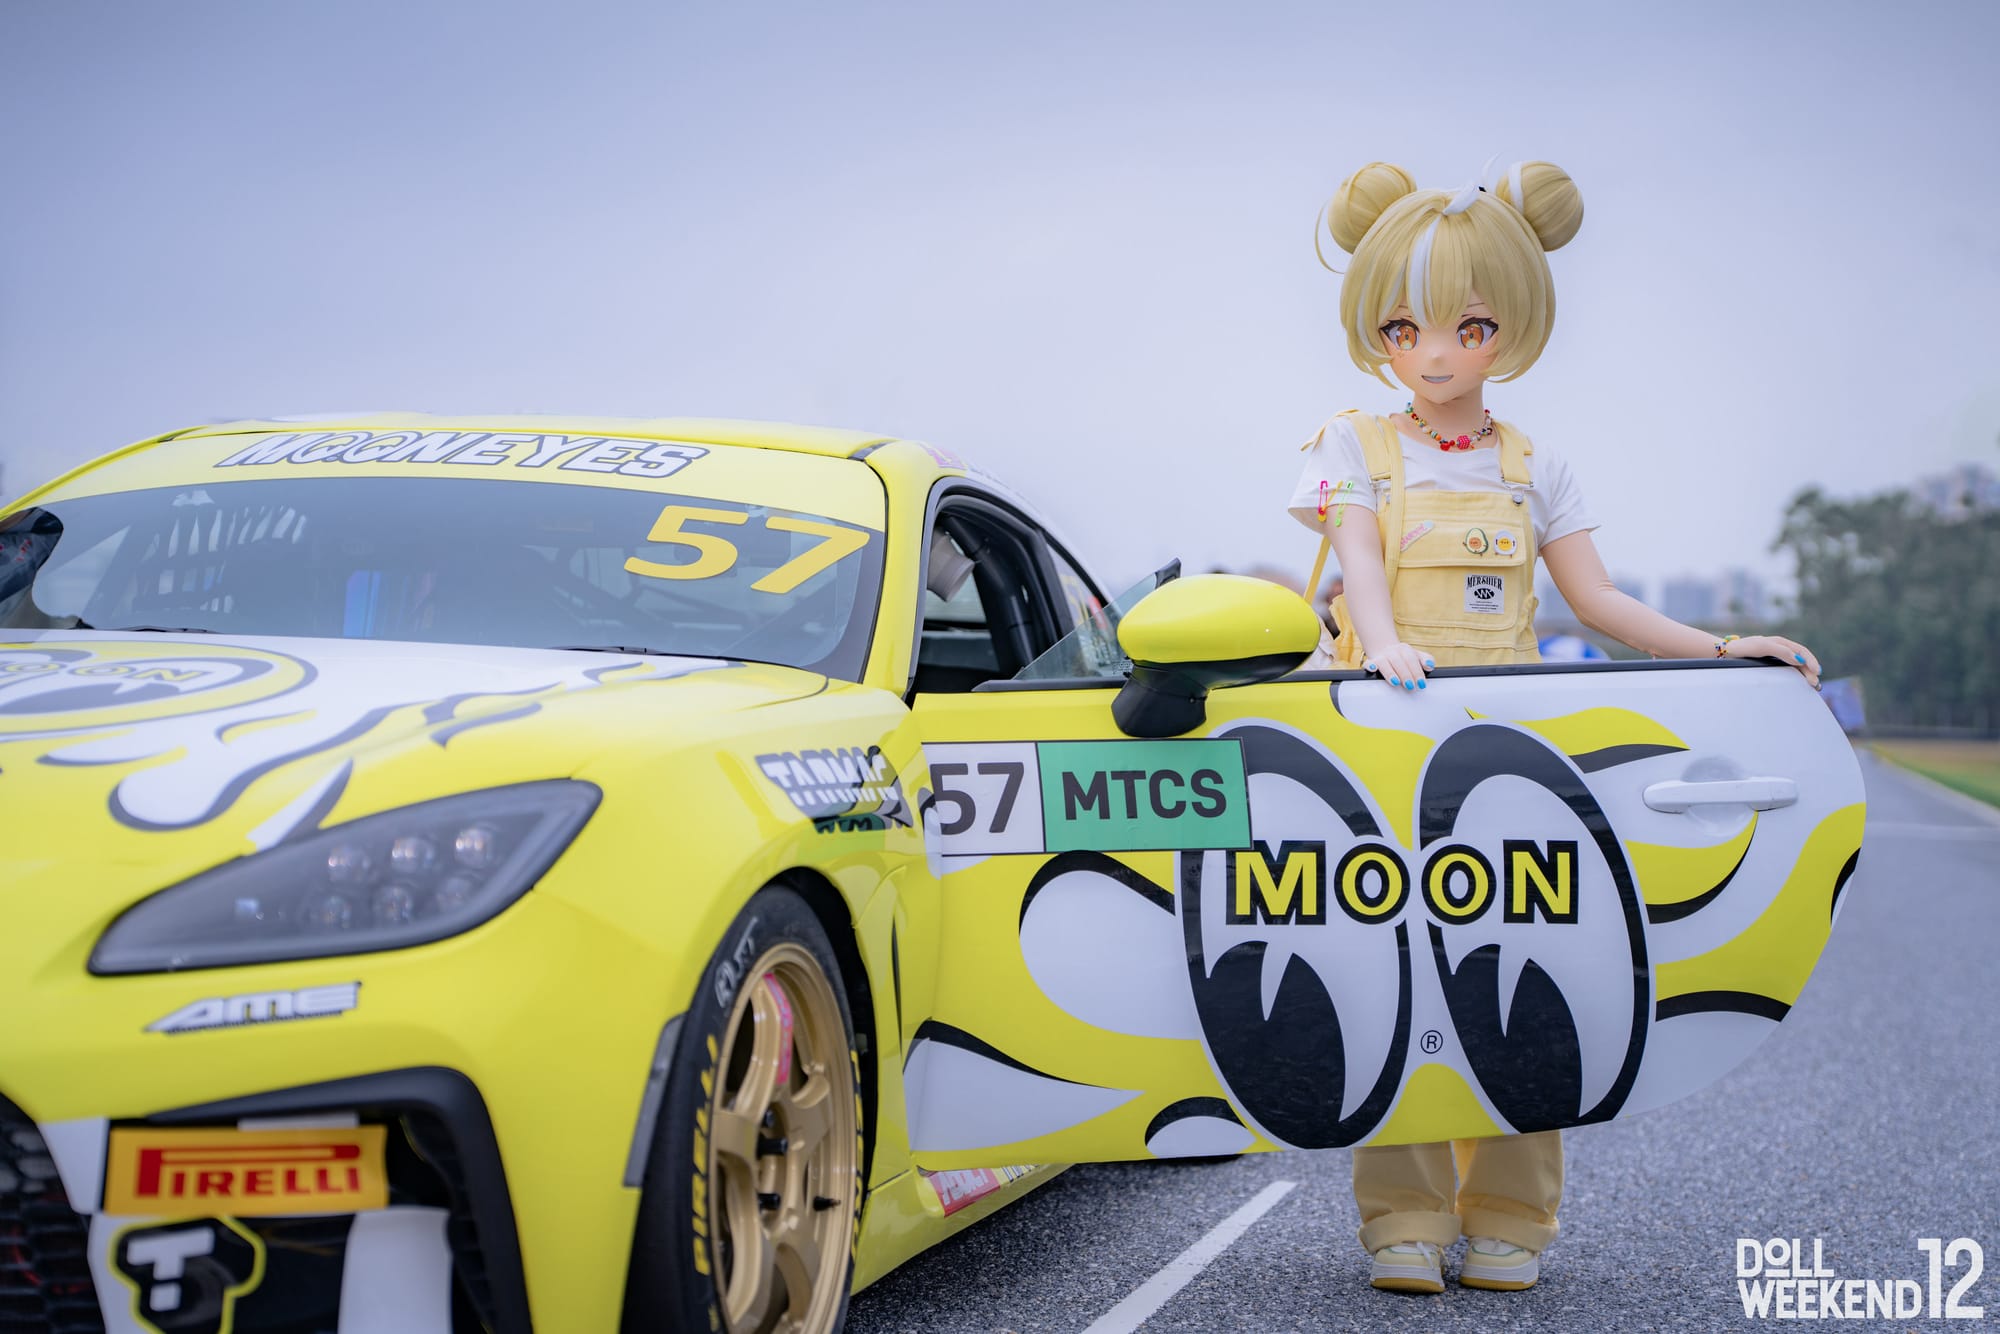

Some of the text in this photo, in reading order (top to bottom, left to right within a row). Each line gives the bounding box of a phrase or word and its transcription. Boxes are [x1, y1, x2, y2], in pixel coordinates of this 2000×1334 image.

[219, 431, 710, 478] MOONEYES
[624, 505, 870, 593] 57
[930, 762, 1024, 836] 57
[1062, 768, 1227, 821] MTCS
[1226, 840, 1578, 925] MOON
[136, 1144, 360, 1197] PIRELLI
